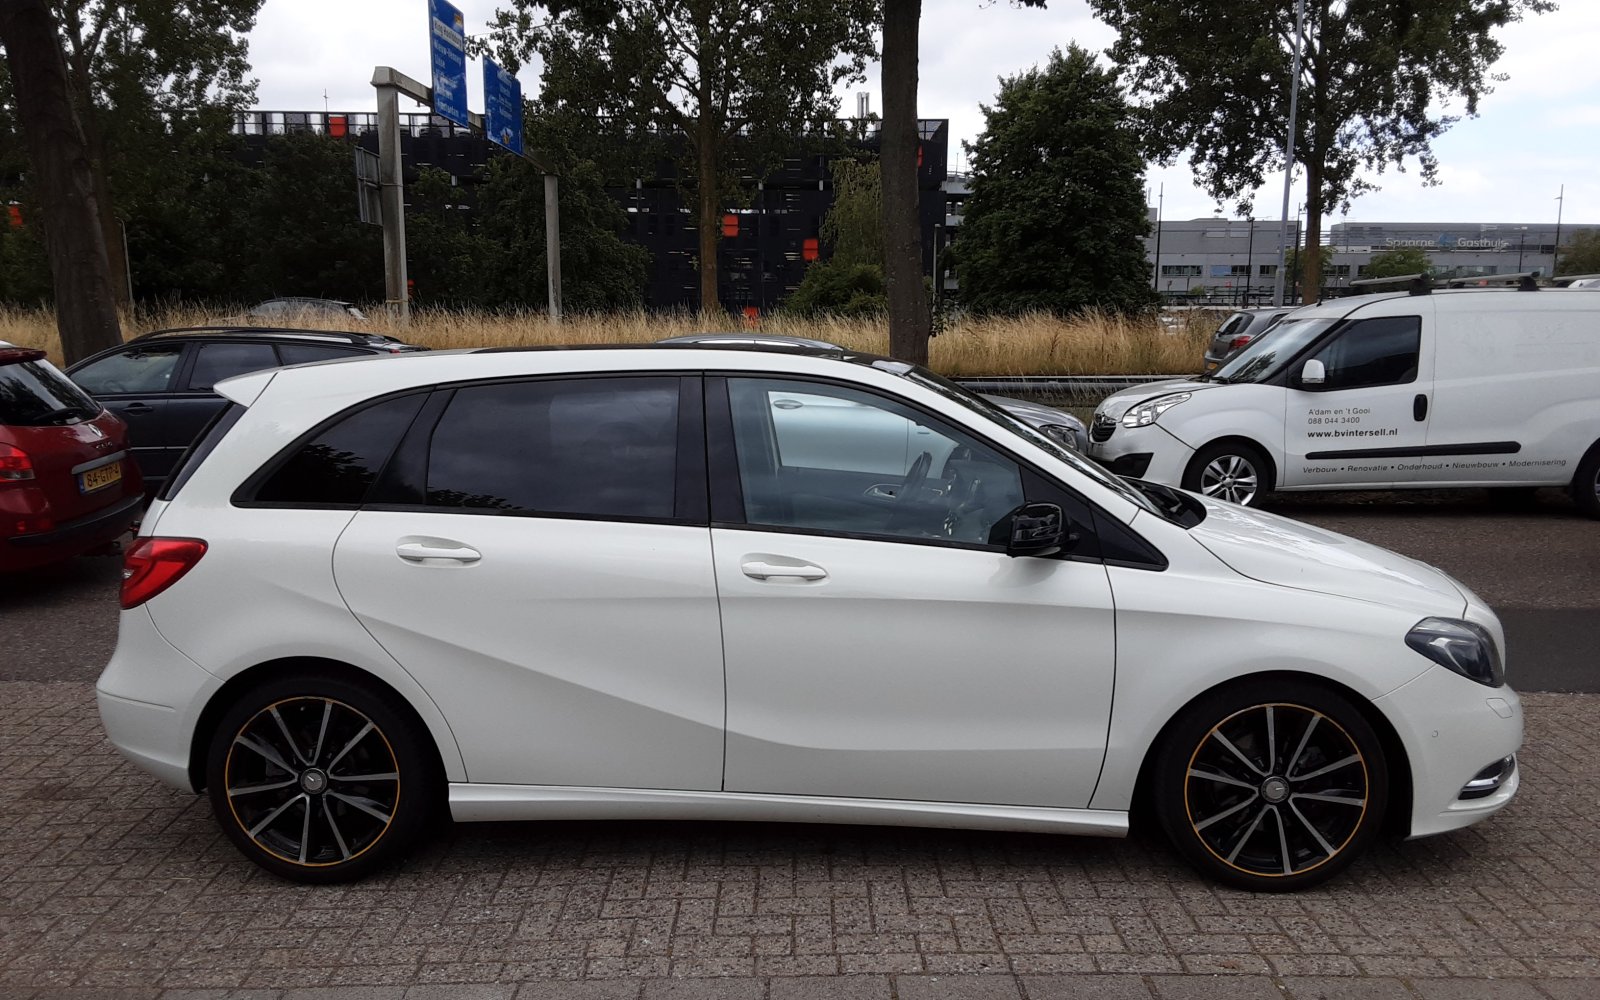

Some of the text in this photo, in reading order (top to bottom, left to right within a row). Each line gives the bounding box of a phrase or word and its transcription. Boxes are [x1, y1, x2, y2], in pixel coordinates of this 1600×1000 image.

[1385, 236, 1506, 249] Spaarne Gasthuis
[1352, 407, 1371, 415] Gooi
[1307, 428, 1398, 438] www.bvintersell.nl
[1397, 463, 1443, 471] Onderhoud
[1452, 461, 1499, 469] Nieuwbouw
[1508, 459, 1566, 467] Modernisering
